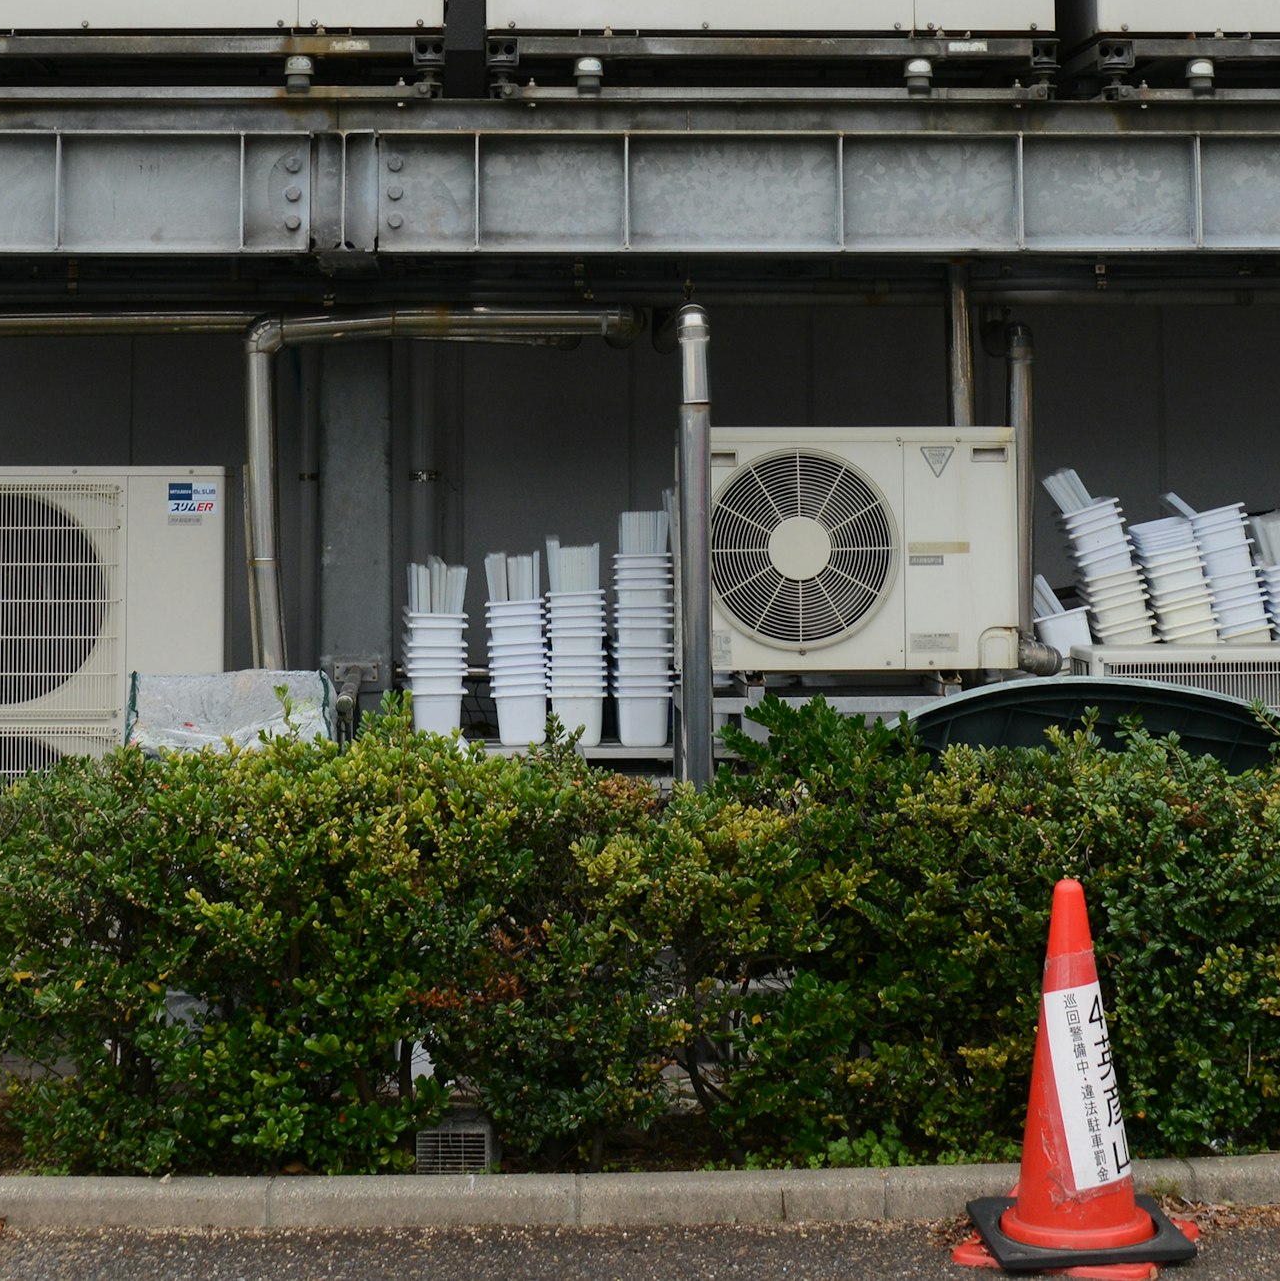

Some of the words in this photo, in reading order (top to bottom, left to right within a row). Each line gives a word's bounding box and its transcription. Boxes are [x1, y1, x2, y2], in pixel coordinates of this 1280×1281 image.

[171, 502, 214, 512] スリムER
[1063, 993, 1109, 1183] 巡回警備中・違法駐車罰金
